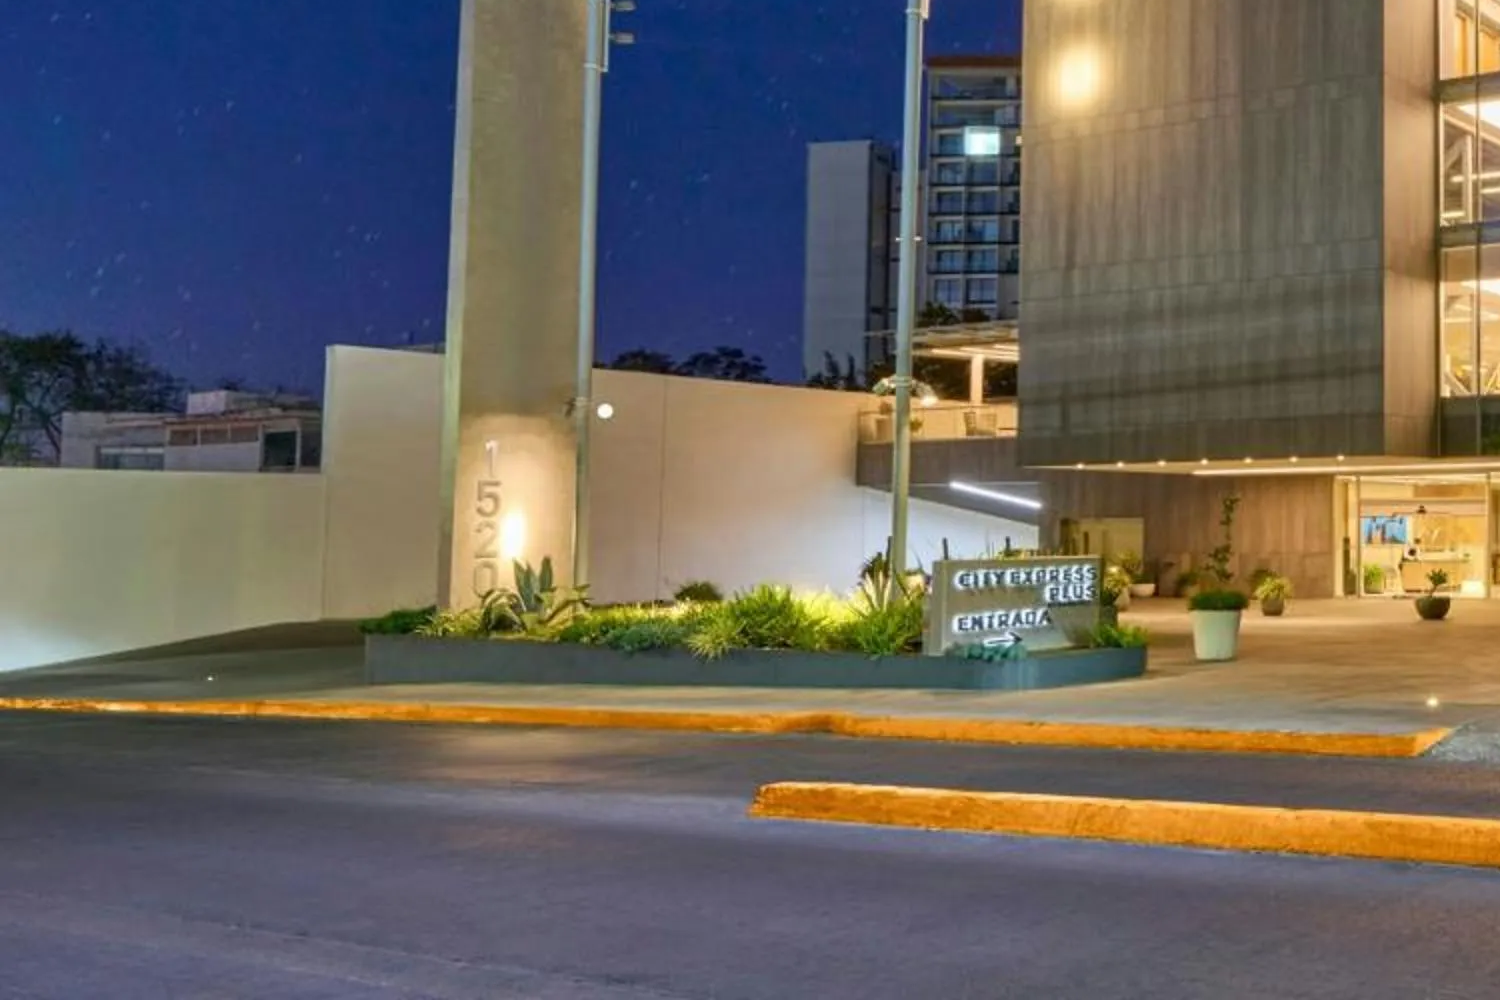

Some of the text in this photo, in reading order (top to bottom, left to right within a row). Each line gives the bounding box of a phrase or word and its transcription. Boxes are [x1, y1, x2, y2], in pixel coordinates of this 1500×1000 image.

[471, 439, 502, 598] 1520
[955, 564, 1098, 589] CITY EXPRESS
[1045, 583, 1098, 602] PLUS
[953, 608, 1053, 633] ENTRADA
